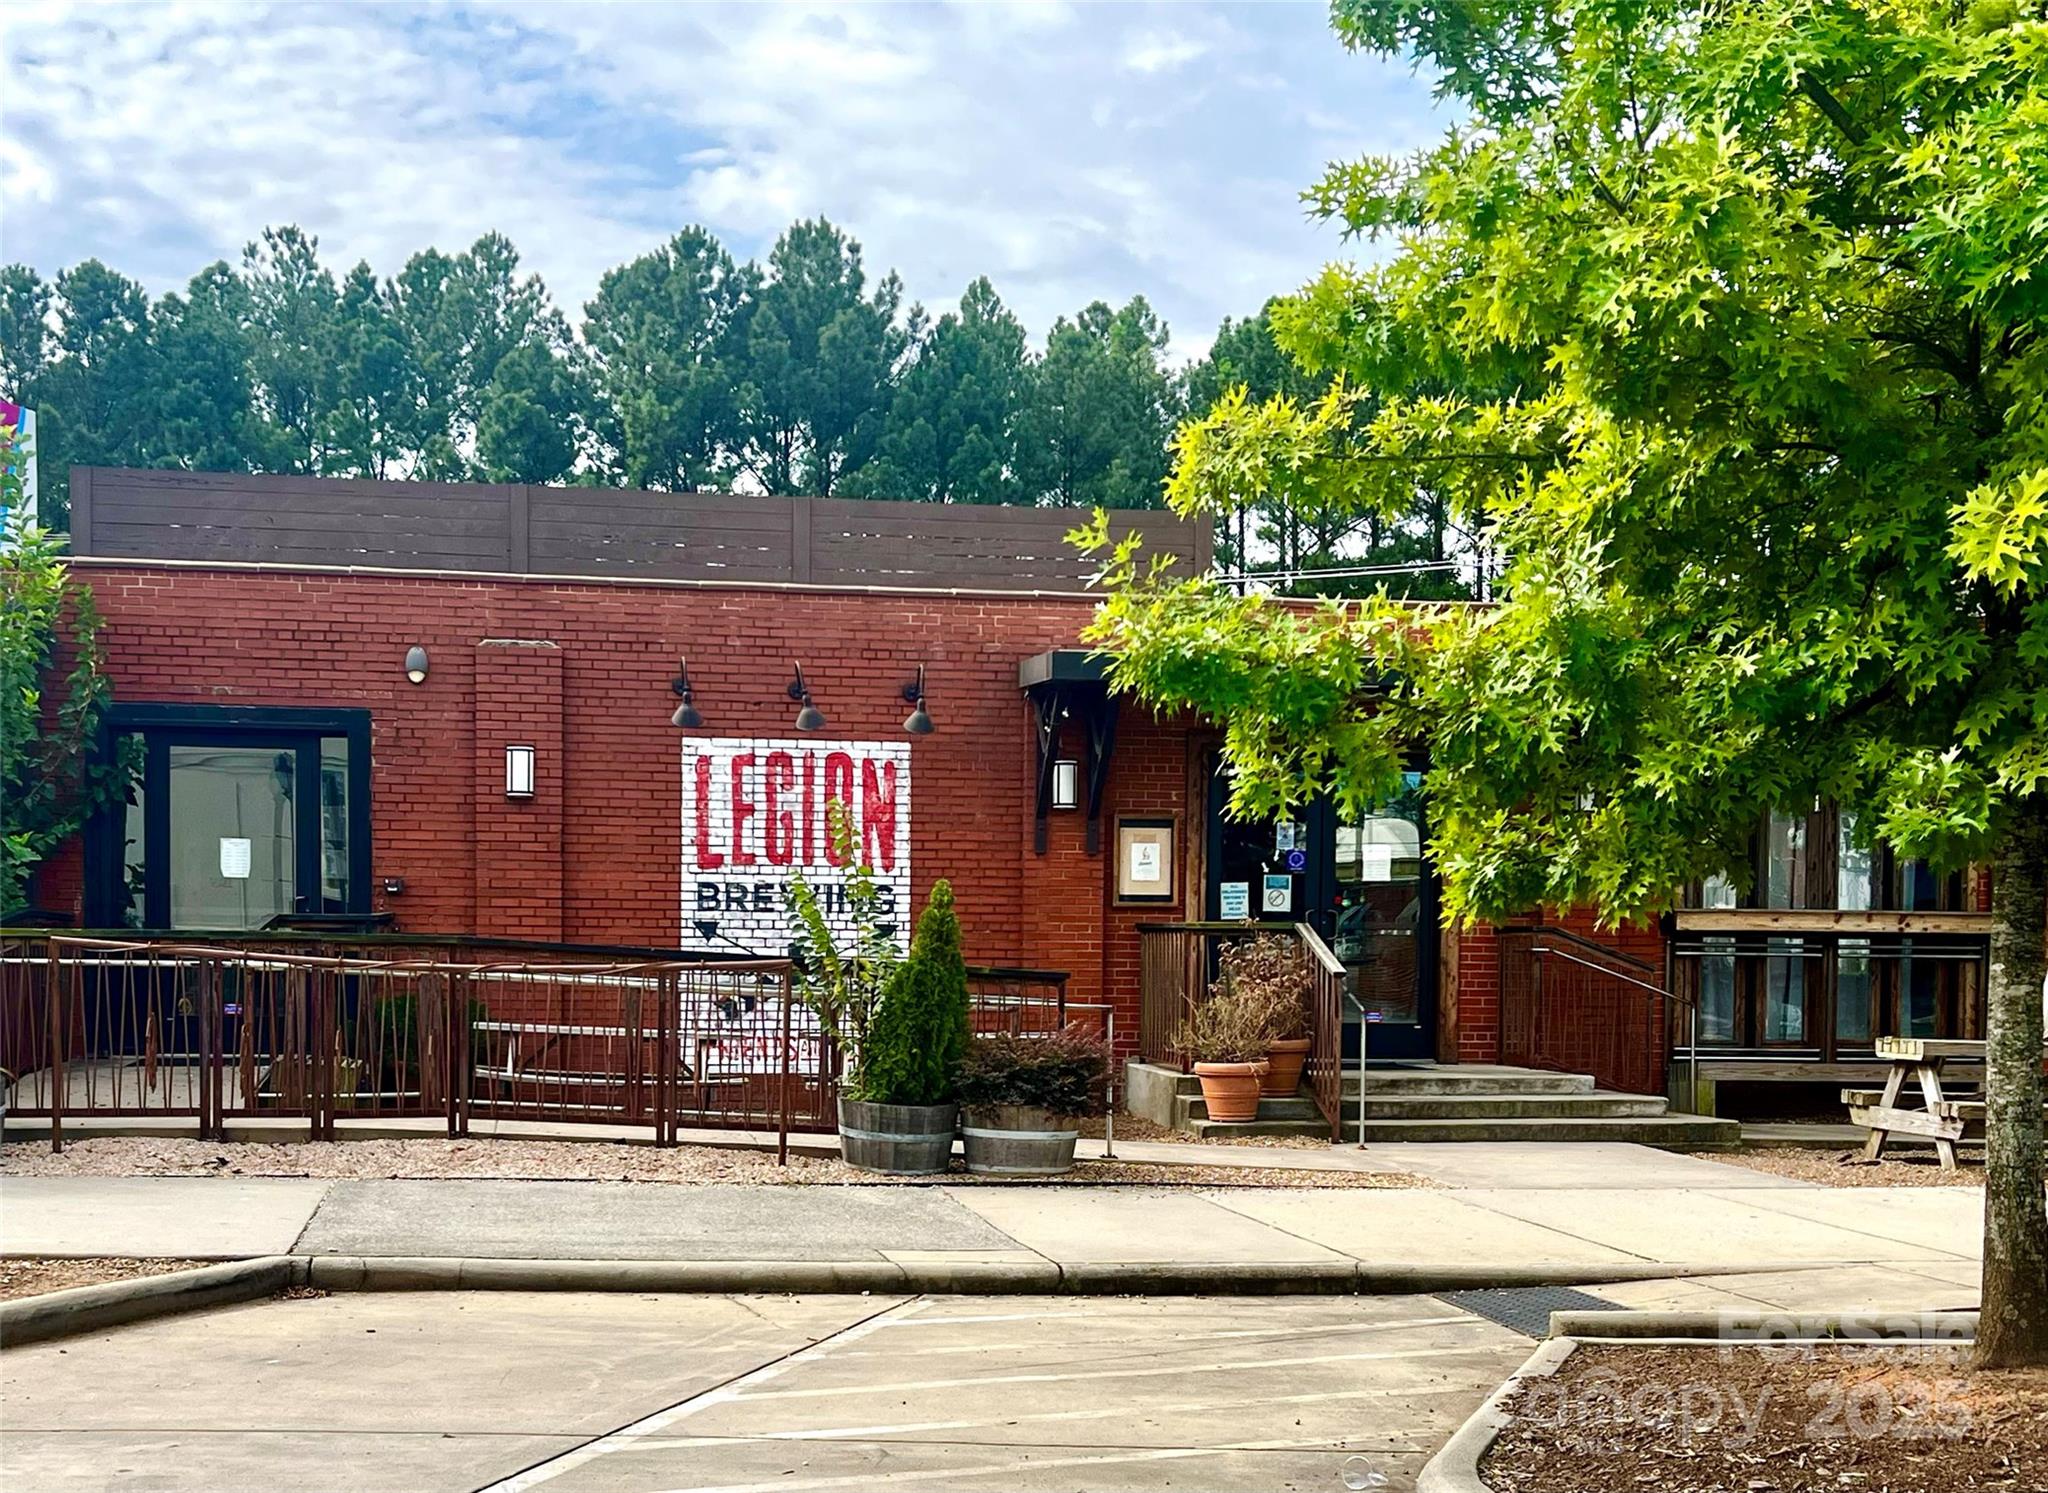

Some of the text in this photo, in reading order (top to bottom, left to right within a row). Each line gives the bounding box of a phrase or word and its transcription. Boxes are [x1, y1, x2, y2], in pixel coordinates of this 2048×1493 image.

[695, 751, 897, 873] LEGION
[696, 882, 895, 914] BREIG
[705, 1037, 797, 1061] RIENDS
